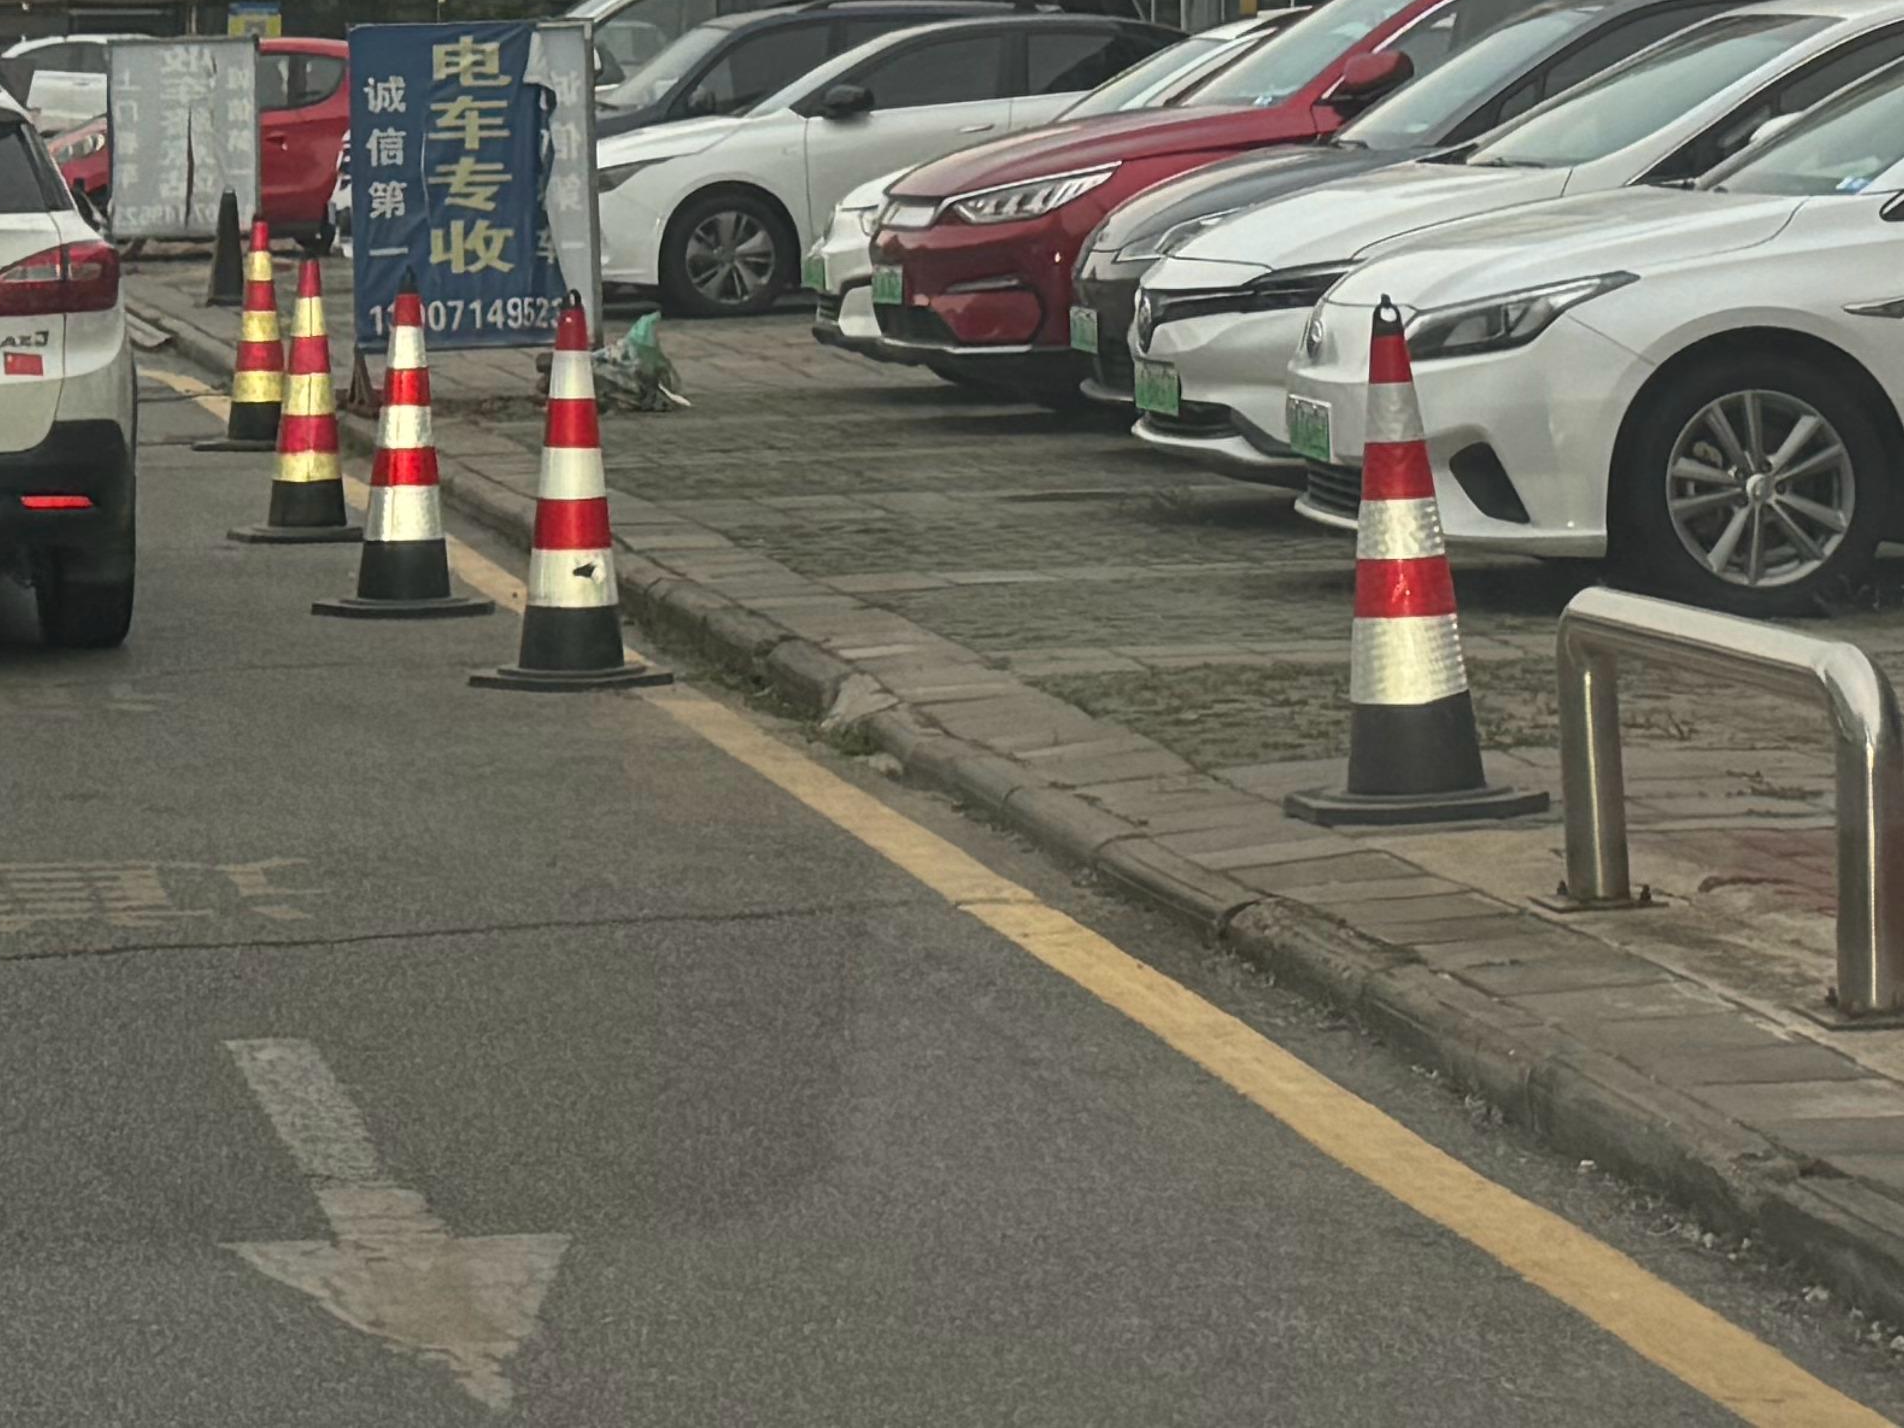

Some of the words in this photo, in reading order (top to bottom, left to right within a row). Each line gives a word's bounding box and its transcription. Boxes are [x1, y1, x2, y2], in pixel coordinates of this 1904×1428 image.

[363, 74, 409, 257] 诚信第一
[427, 34, 516, 275] 电车专收
[369, 297, 563, 337] 107149523
